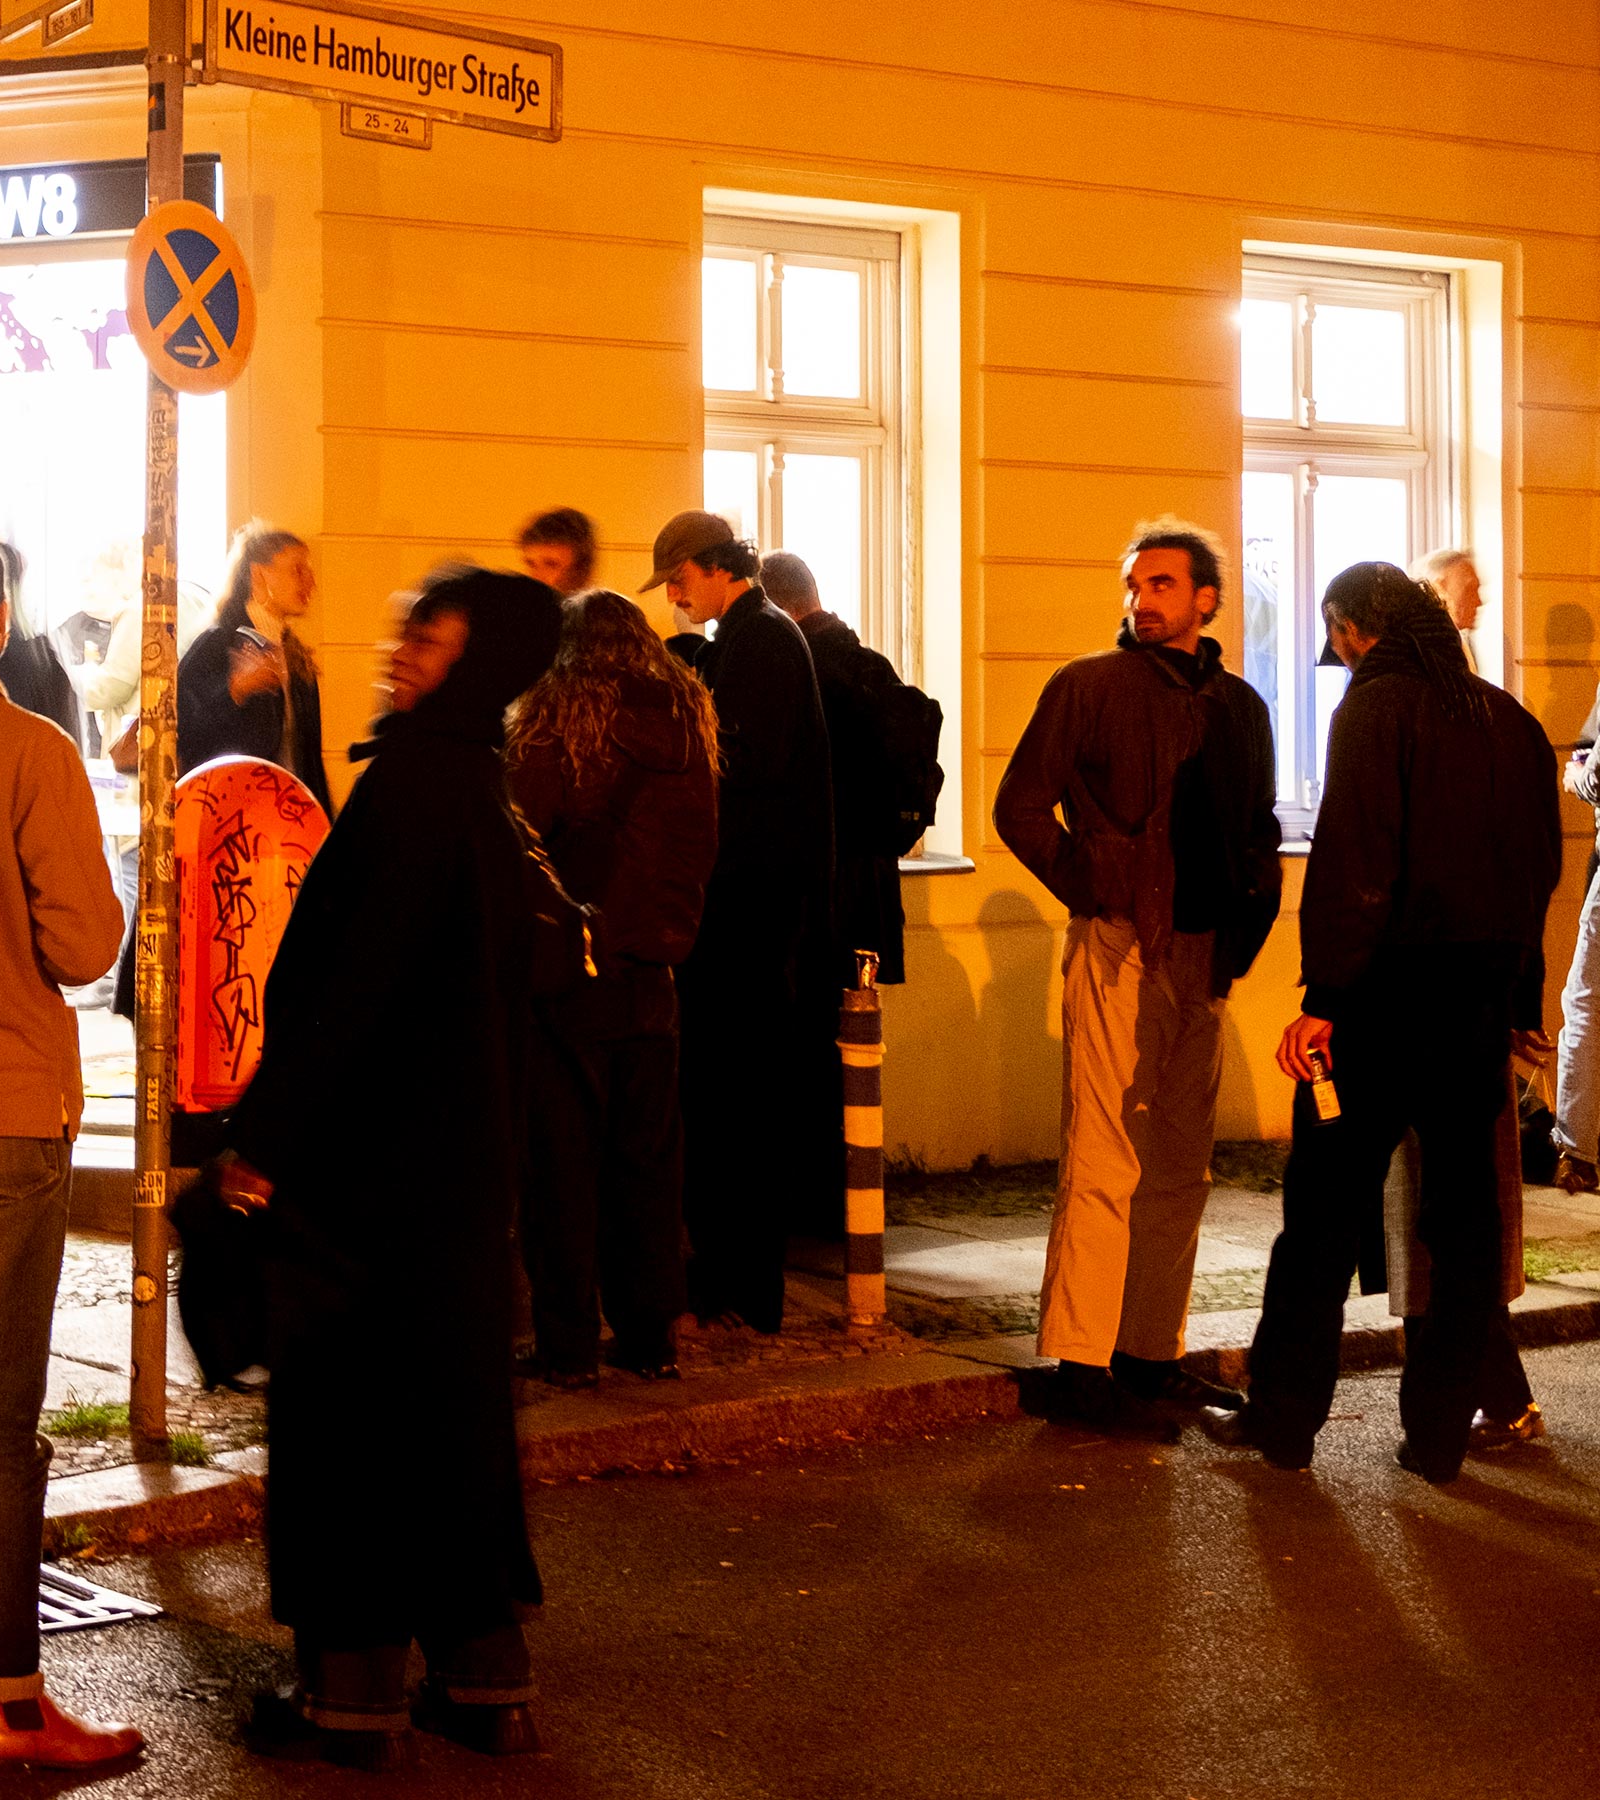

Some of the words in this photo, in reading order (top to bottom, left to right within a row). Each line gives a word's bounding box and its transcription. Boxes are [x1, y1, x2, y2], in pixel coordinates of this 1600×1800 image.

[225, 7, 307, 63] Kleine
[313, 24, 457, 96] Hamburger
[462, 53, 540, 114] Straße
[365, 112, 380, 129] 25
[393, 117, 409, 134] 24
[146, 1077, 159, 1122] FAKE
